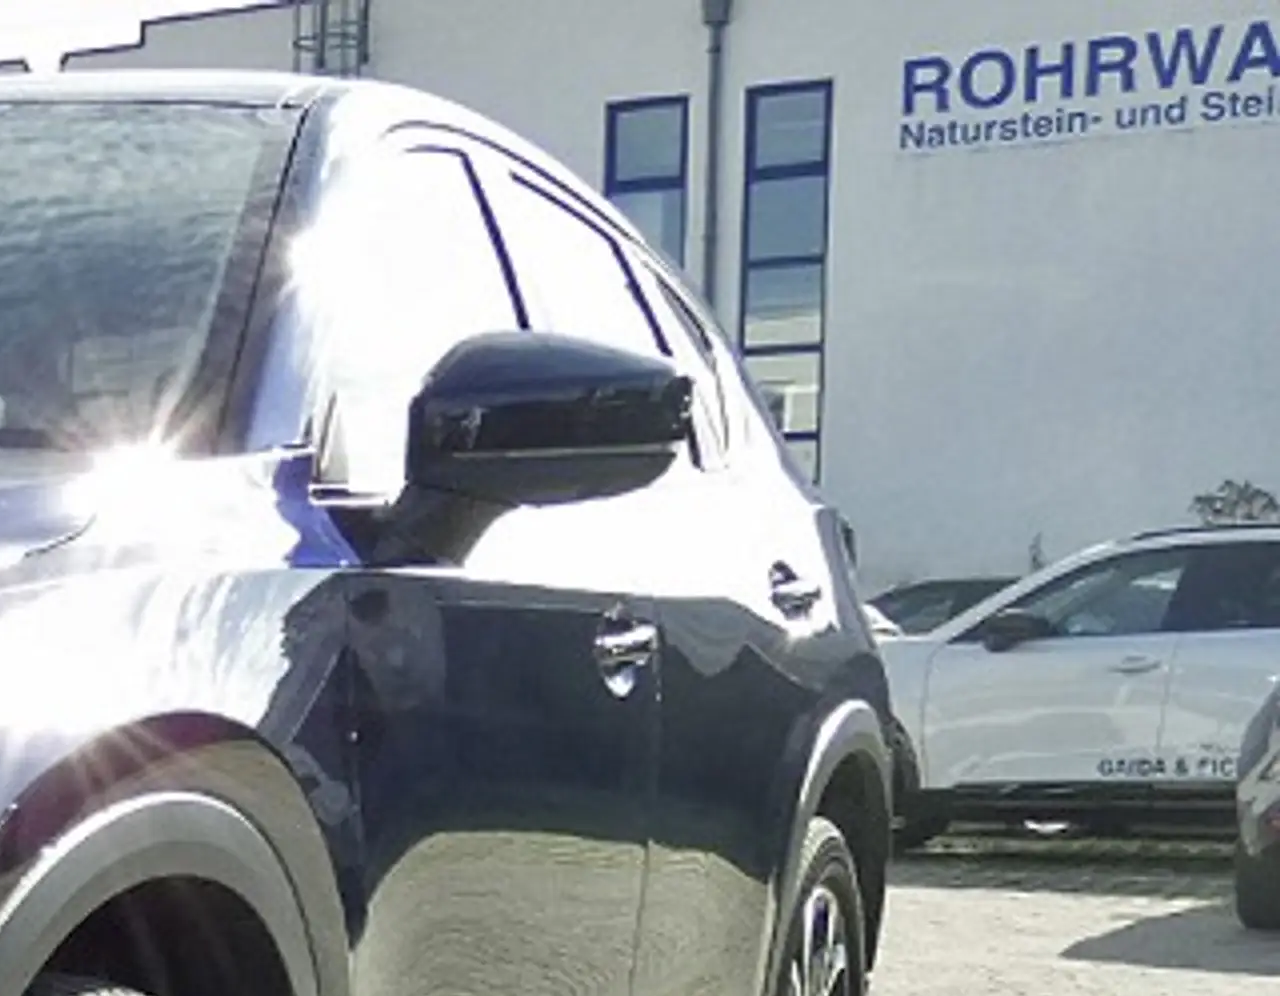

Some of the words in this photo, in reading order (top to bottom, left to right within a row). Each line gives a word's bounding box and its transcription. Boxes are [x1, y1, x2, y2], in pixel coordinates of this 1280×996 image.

[902, 20, 1280, 116] ROHRWA
[899, 114, 1102, 149] Naturstein-
[1115, 95, 1188, 130] und
